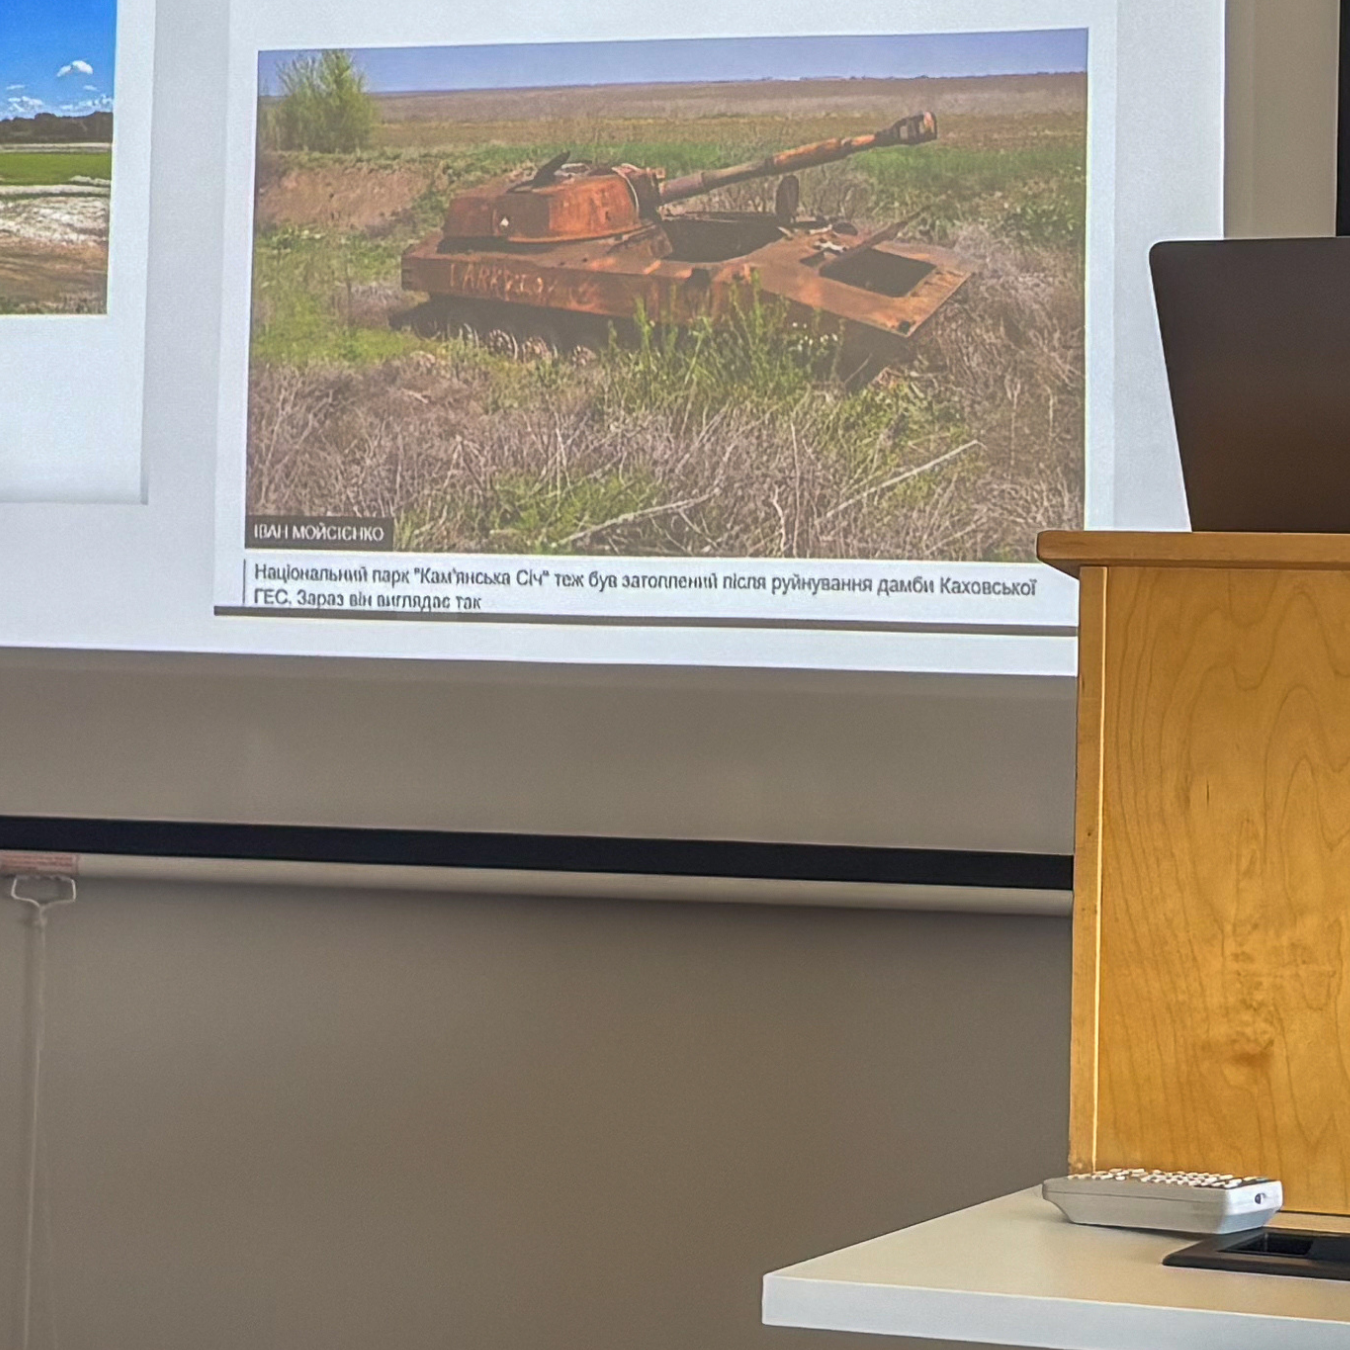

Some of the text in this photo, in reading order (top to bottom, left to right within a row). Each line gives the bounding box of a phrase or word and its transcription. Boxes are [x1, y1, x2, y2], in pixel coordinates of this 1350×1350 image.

[254, 523, 288, 540] ІВАН
[254, 563, 368, 583] Національний
[372, 569, 410, 586] парк
[554, 574, 584, 587] теж
[588, 570, 617, 591] був
[722, 574, 766, 591] після
[771, 573, 873, 596] руйнування
[877, 575, 935, 597] дамби
[939, 577, 1037, 597] Каховської
[296, 590, 344, 609] Зараз
[349, 591, 372, 607] він
[455, 596, 482, 611] так
